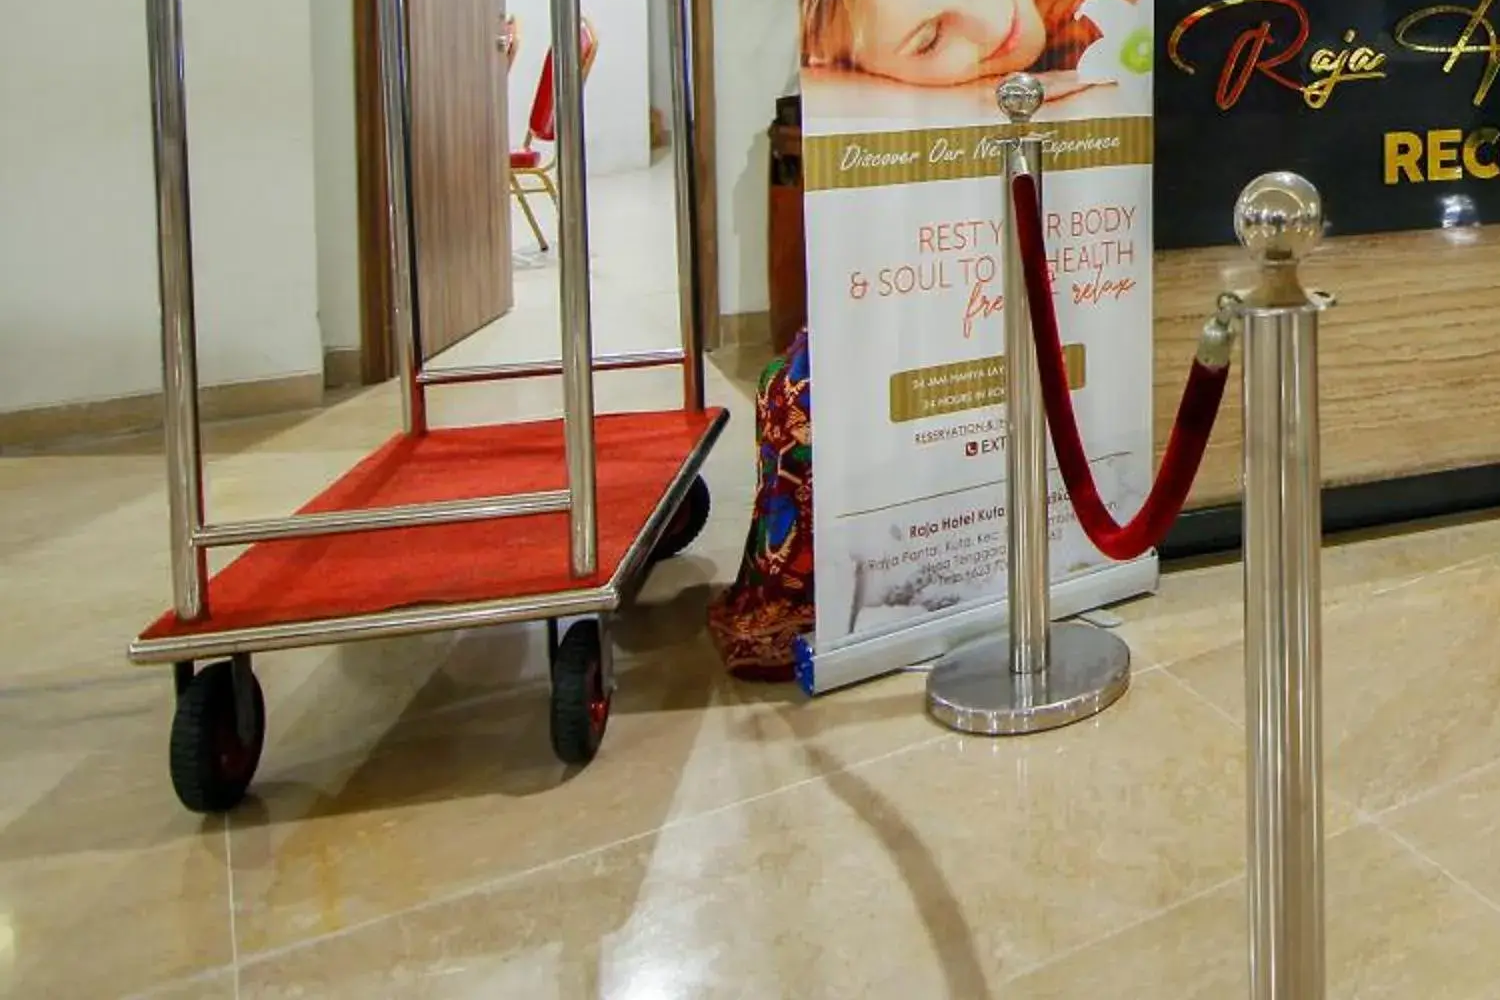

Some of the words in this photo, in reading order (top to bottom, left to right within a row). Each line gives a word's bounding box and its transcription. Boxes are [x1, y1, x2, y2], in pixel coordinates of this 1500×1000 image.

[840, 144, 920, 171] Discover
[928, 138, 964, 163] Our
[1036, 131, 1121, 162] Experience
[918, 222, 983, 253] REST
[1071, 206, 1136, 237] BODY
[878, 262, 952, 296] SOUL
[958, 256, 995, 285] TO
[909, 522, 939, 538] Raja
[942, 512, 974, 530] Hotel
[978, 507, 1005, 521] Kuta
